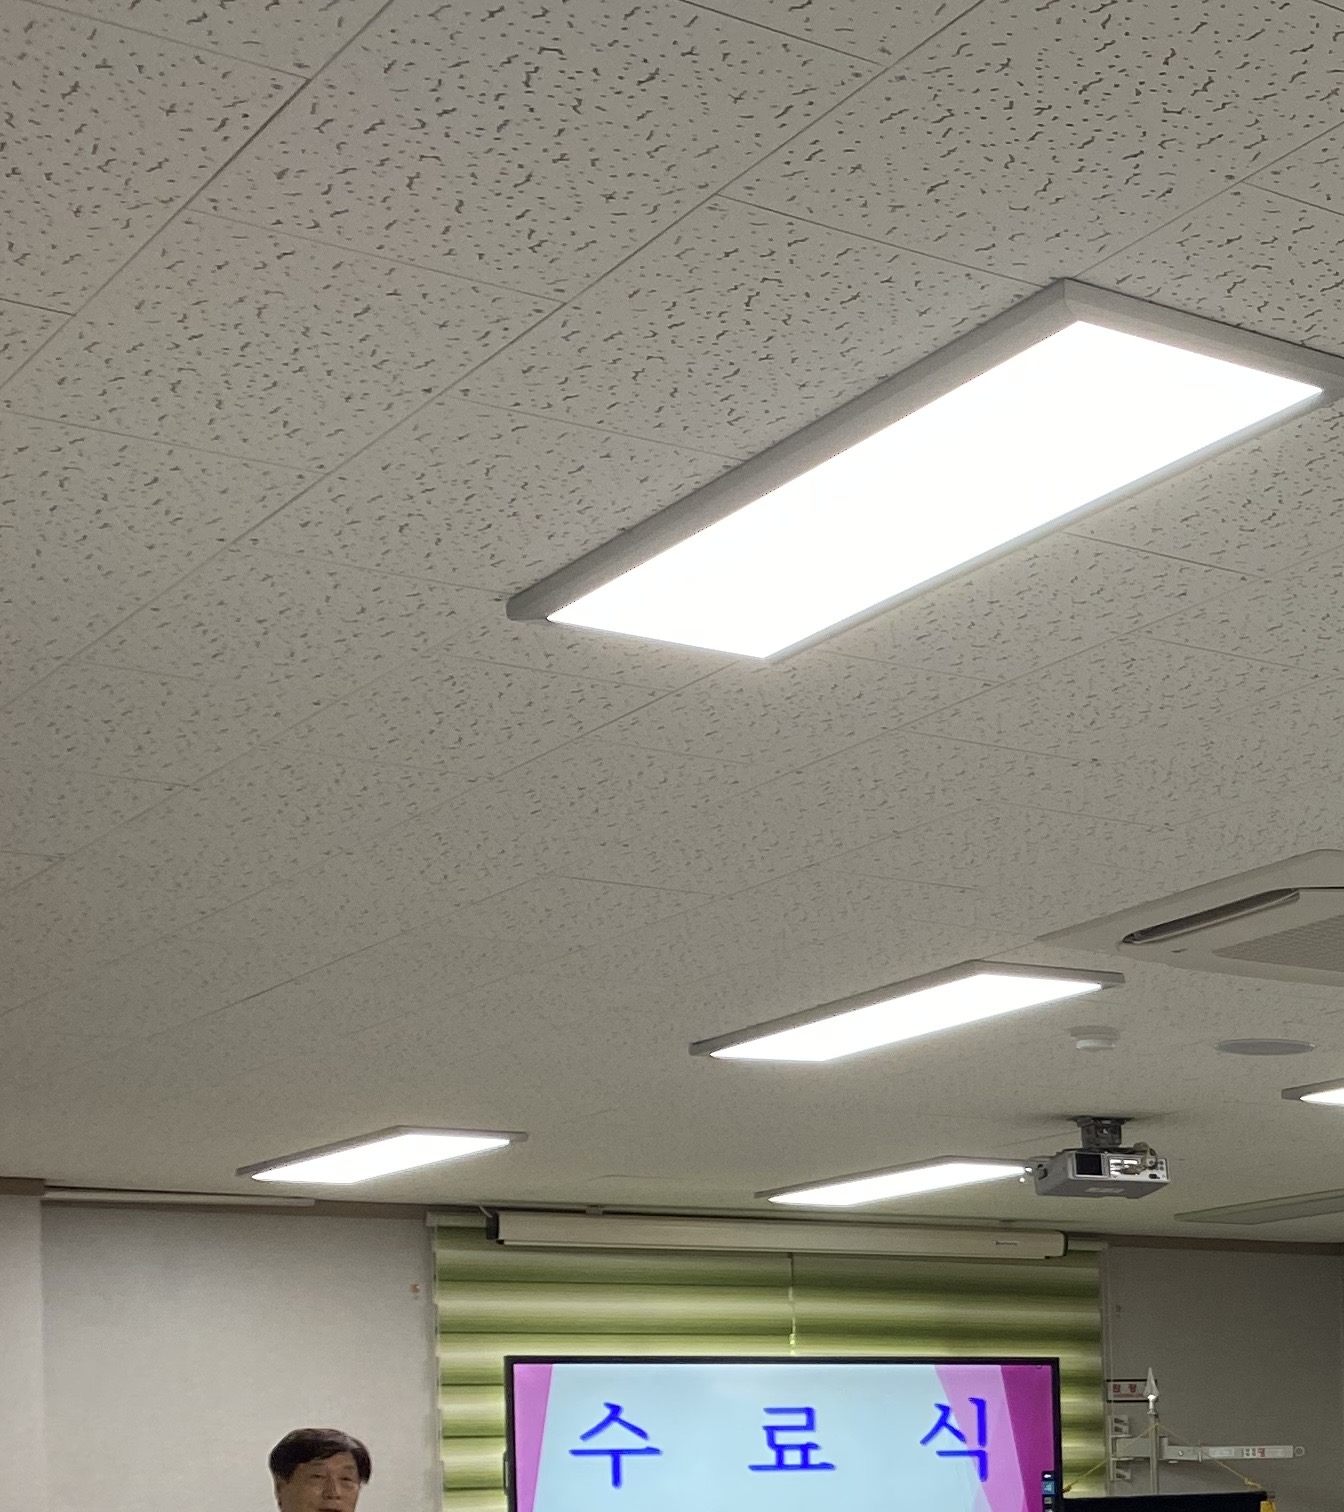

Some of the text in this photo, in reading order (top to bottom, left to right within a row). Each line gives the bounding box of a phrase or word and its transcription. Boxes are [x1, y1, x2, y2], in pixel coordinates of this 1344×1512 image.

[568, 1397, 989, 1489] 수 료 식
